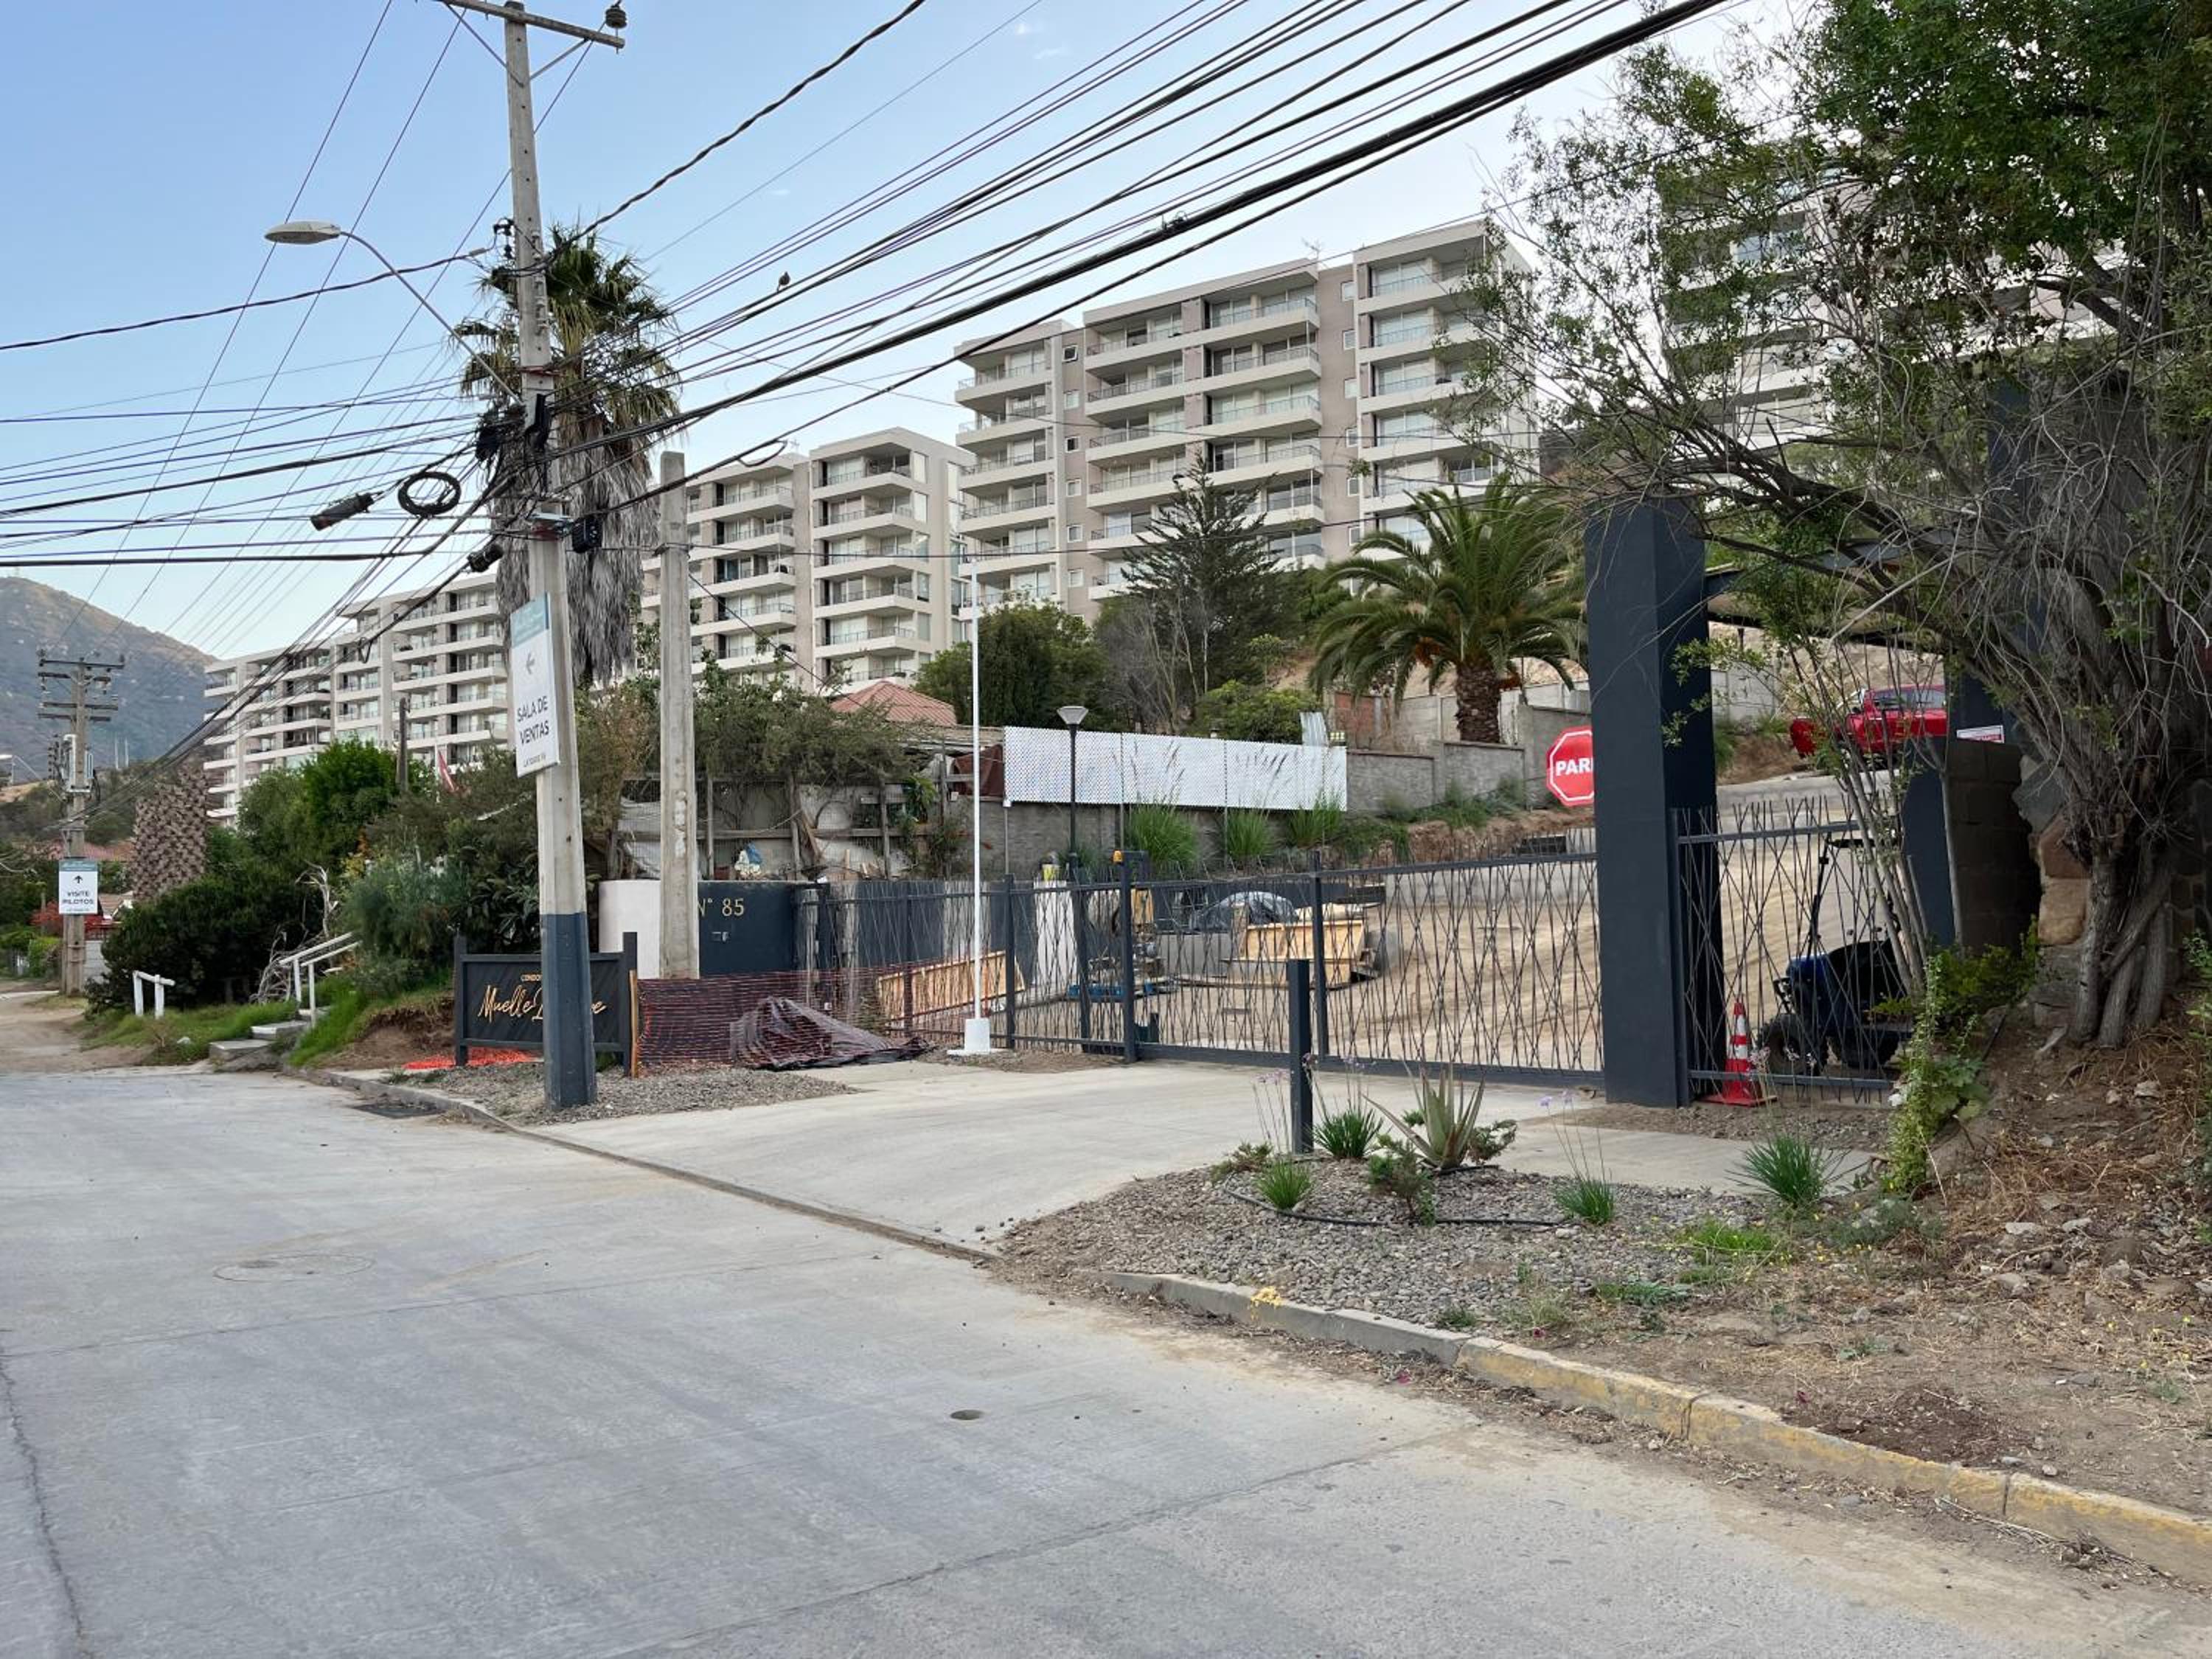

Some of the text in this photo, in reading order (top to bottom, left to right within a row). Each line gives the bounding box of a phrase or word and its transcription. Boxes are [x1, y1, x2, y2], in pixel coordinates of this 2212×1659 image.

[518, 696, 548, 722] SALA DE
[520, 720, 549, 745] VENTAS
[1555, 757, 1593, 776] PAR
[722, 898, 744, 917] 85
[478, 985, 533, 1023] Muelle
